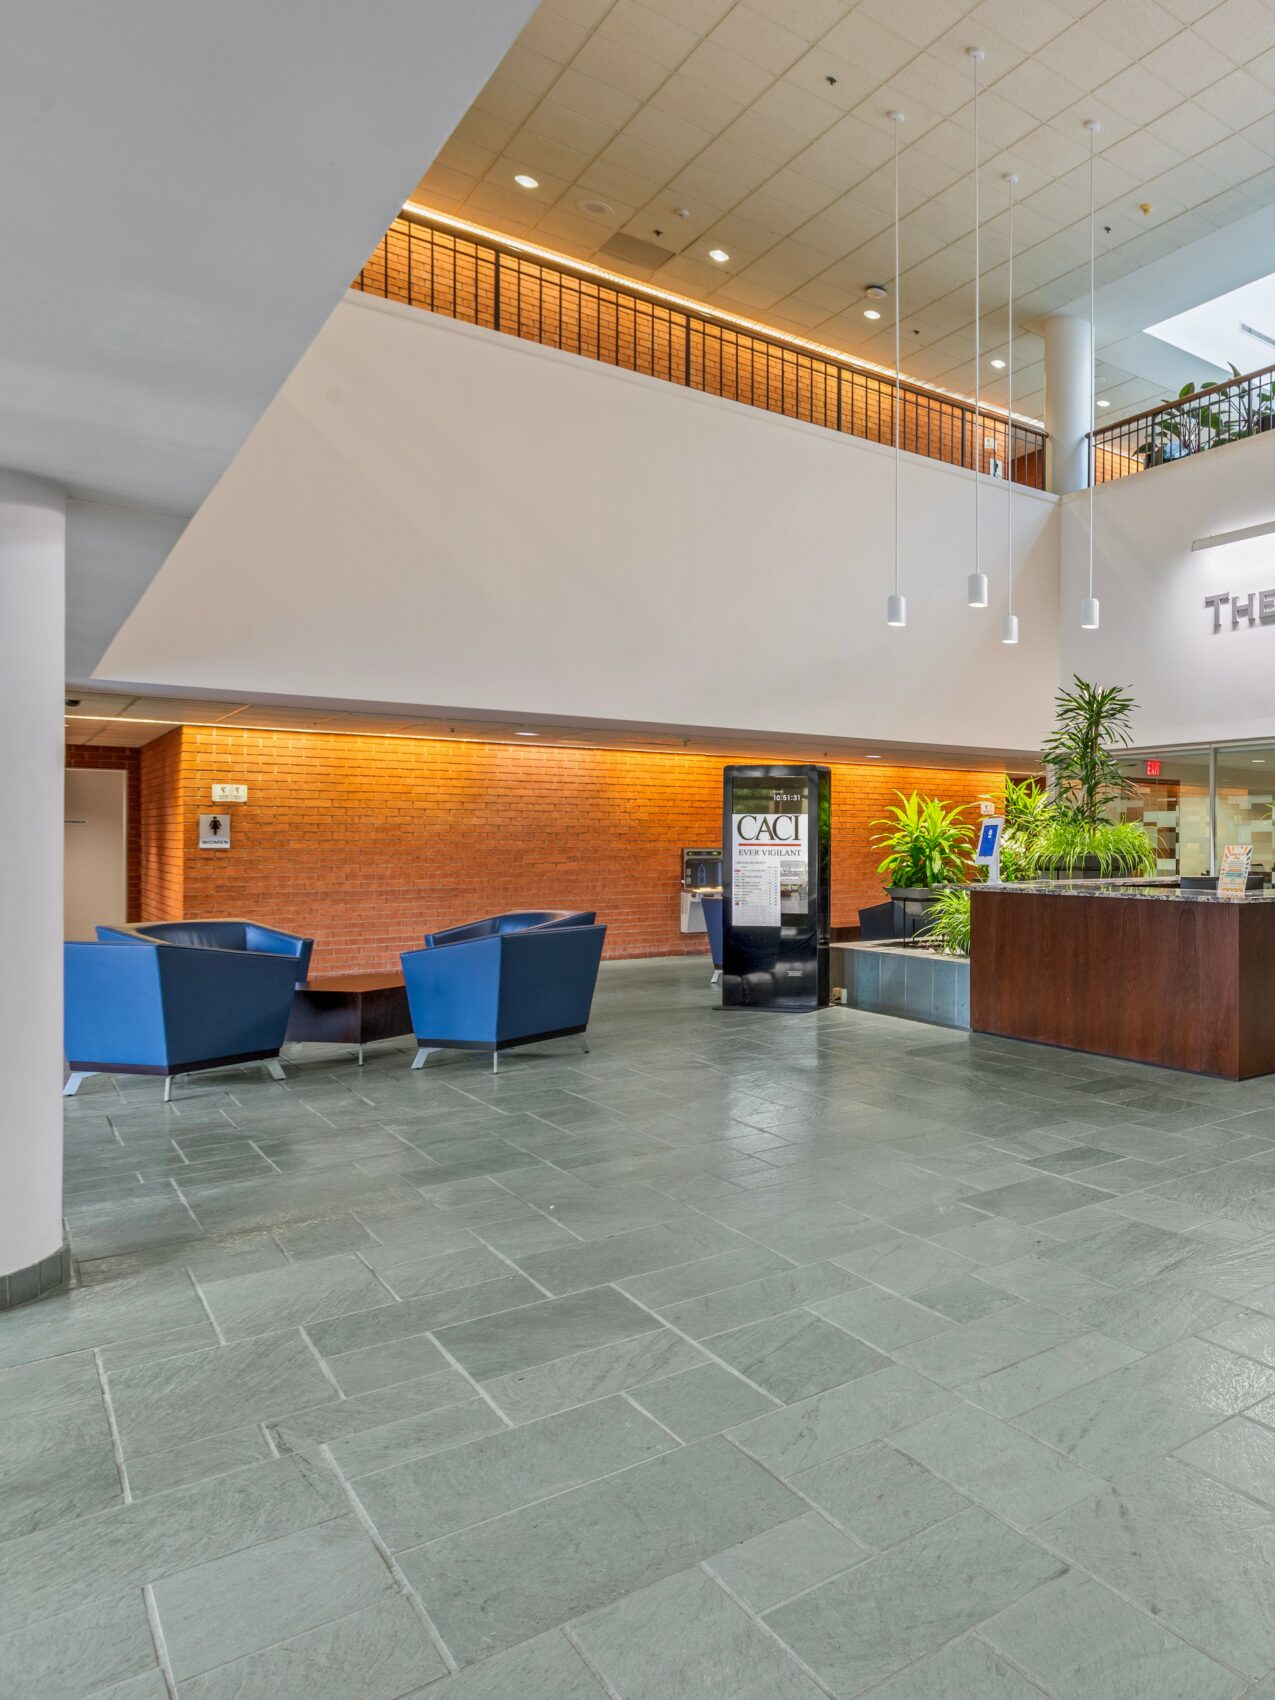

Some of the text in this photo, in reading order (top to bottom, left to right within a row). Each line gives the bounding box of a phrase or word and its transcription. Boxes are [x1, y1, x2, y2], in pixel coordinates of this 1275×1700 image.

[1147, 761, 1160, 775] EXIT
[737, 814, 802, 841] CACI
[738, 849, 802, 857] EVER VIGILANT
